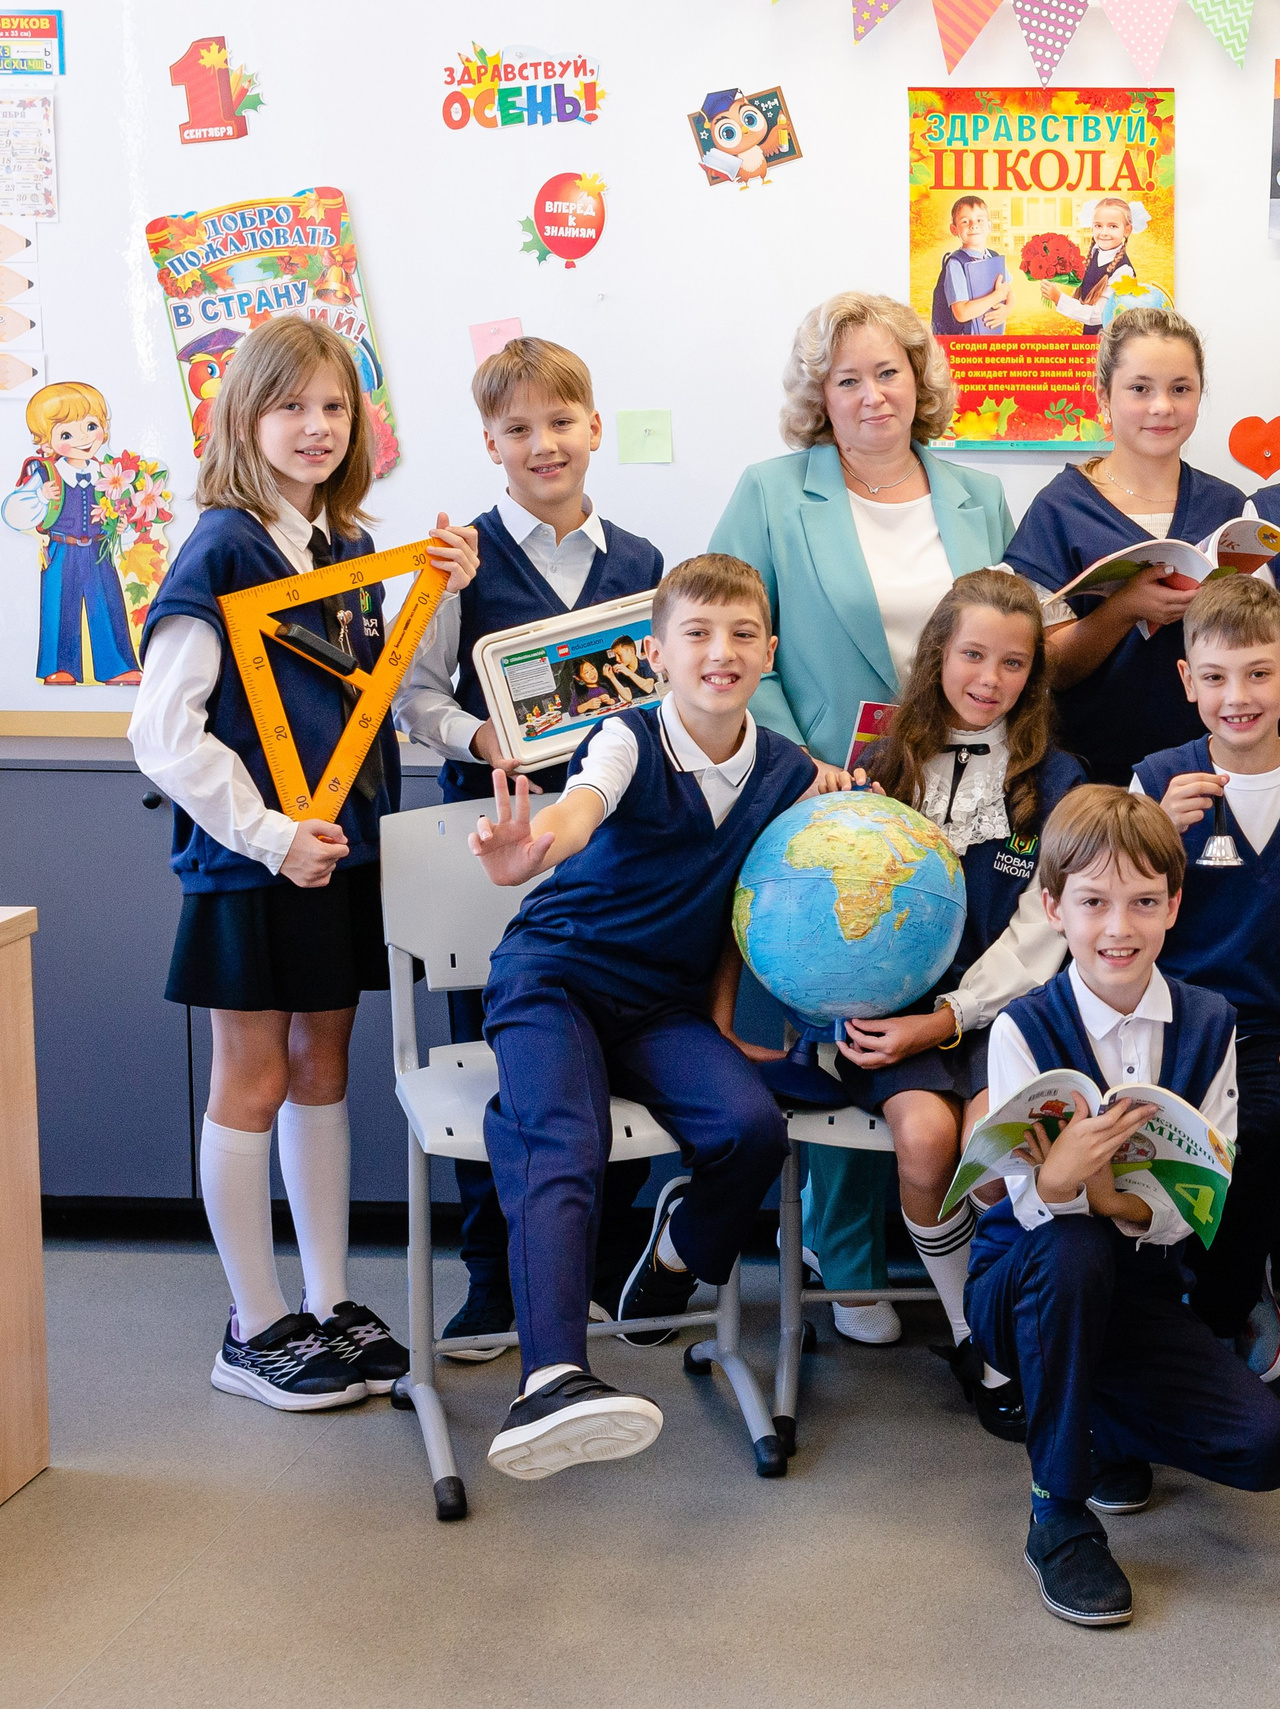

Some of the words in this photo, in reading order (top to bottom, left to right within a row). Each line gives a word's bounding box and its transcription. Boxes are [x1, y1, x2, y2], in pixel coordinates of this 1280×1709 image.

[0, 17, 50, 29] ВУКОВ
[443, 53, 595, 86] ЗДРАВСТВУЙ,
[170, 36, 248, 144] 1
[442, 81, 599, 131] ОСЕНЬ!
[183, 125, 234, 140] СЕНТЯБРЯ
[926, 107, 1158, 147] ЗДРАВСТВУЙ,
[928, 148, 1157, 193] ШКОЛА!
[544, 199, 596, 217] ВПЕРЁД
[204, 205, 293, 241] ДОБРО
[567, 215, 578, 228] К
[544, 225, 596, 241] ЗНАНИЯМ
[166, 225, 337, 278] ПОЖАЛОВАТЬ
[171, 303, 194, 329] В
[201, 280, 309, 322] СТРАНУ
[950, 341, 987, 352] Сегодня
[990, 342, 1018, 352] двери
[1020, 342, 1070, 352] открывает
[950, 356, 983, 364] Звонок
[985, 355, 1025, 364] веселый
[1026, 356, 1032, 364] в
[1034, 356, 1066, 364] классы
[950, 369, 966, 379] Где
[967, 370, 1007, 379] ожидает
[1010, 370, 1038, 378] много
[1040, 368, 1074, 378] знаний
[959, 384, 986, 392] ярких
[988, 380, 1048, 392] впечатлений
[1050, 382, 1080, 392] целый
[412, 553, 428, 567] 30
[350, 570, 364, 584] 20
[286, 589, 300, 602] 10
[418, 591, 430, 606] 10
[571, 638, 604, 652] education
[252, 656, 264, 671] 10
[389, 650, 402, 666] 20
[358, 713, 372, 730] 30
[274, 724, 288, 741] 20
[328, 776, 342, 793] 40
[296, 794, 310, 811] 30
[996, 851, 1034, 870] НОВАЯ
[993, 861, 1032, 880] ШКОЛА
[1174, 1183, 1216, 1225] 4
